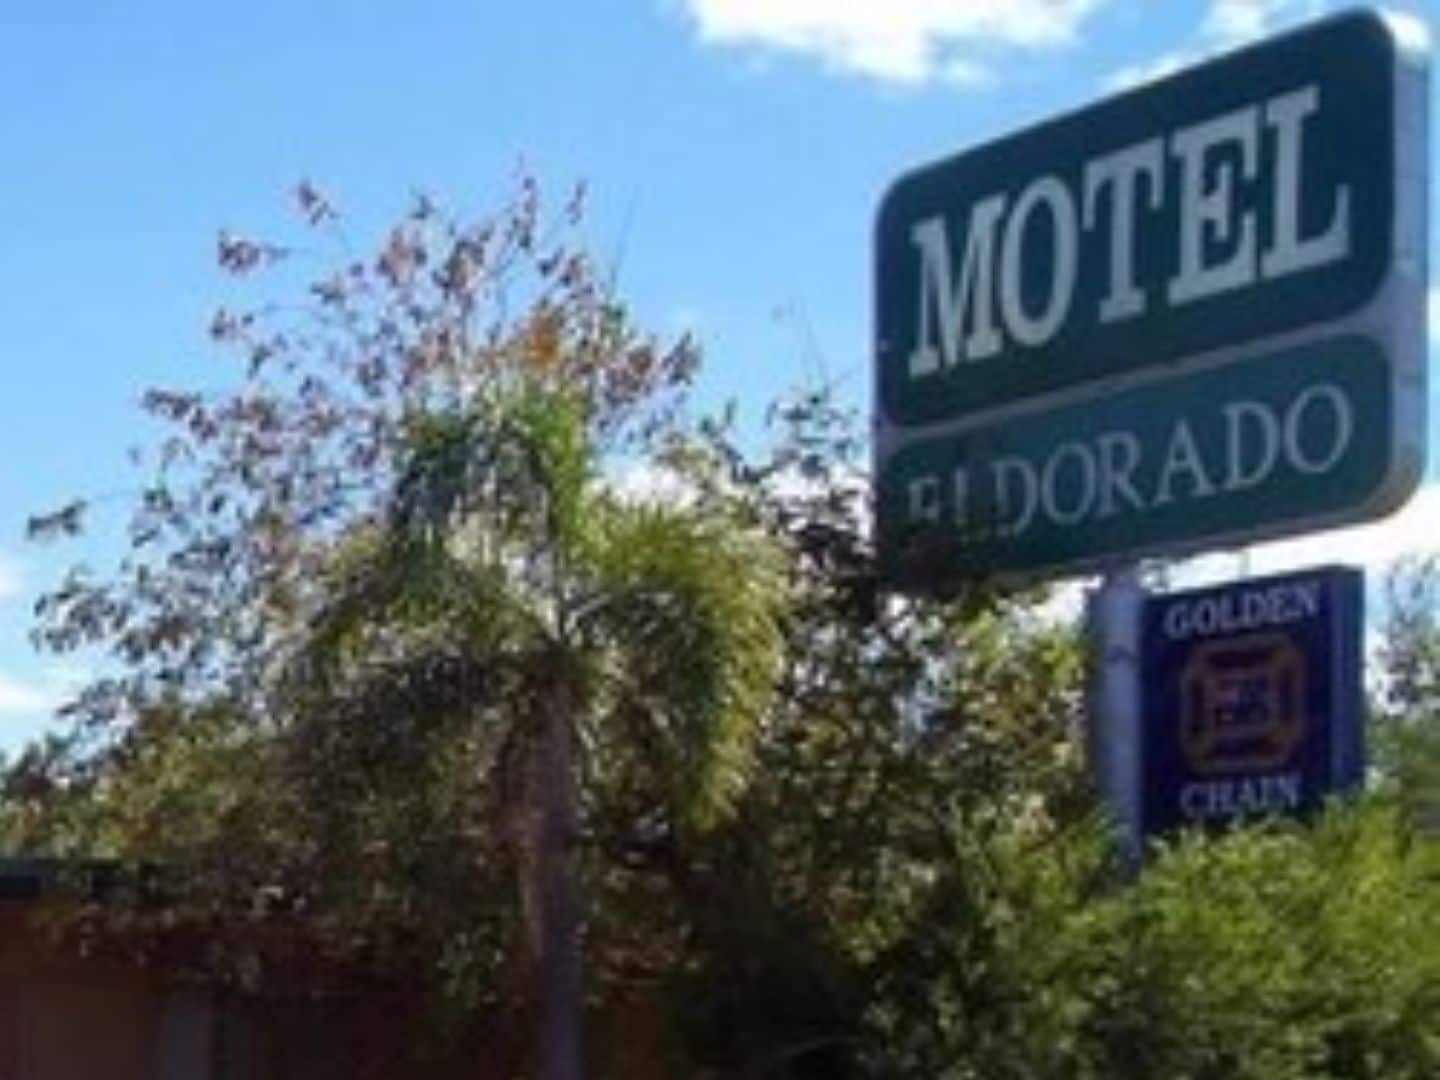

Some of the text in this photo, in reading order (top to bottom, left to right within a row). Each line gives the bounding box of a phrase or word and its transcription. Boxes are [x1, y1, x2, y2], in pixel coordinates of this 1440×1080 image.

[908, 84, 1350, 377] MOTEL
[1163, 582, 1320, 640] GOLDEN
[1180, 771, 1302, 817] CHAIN
